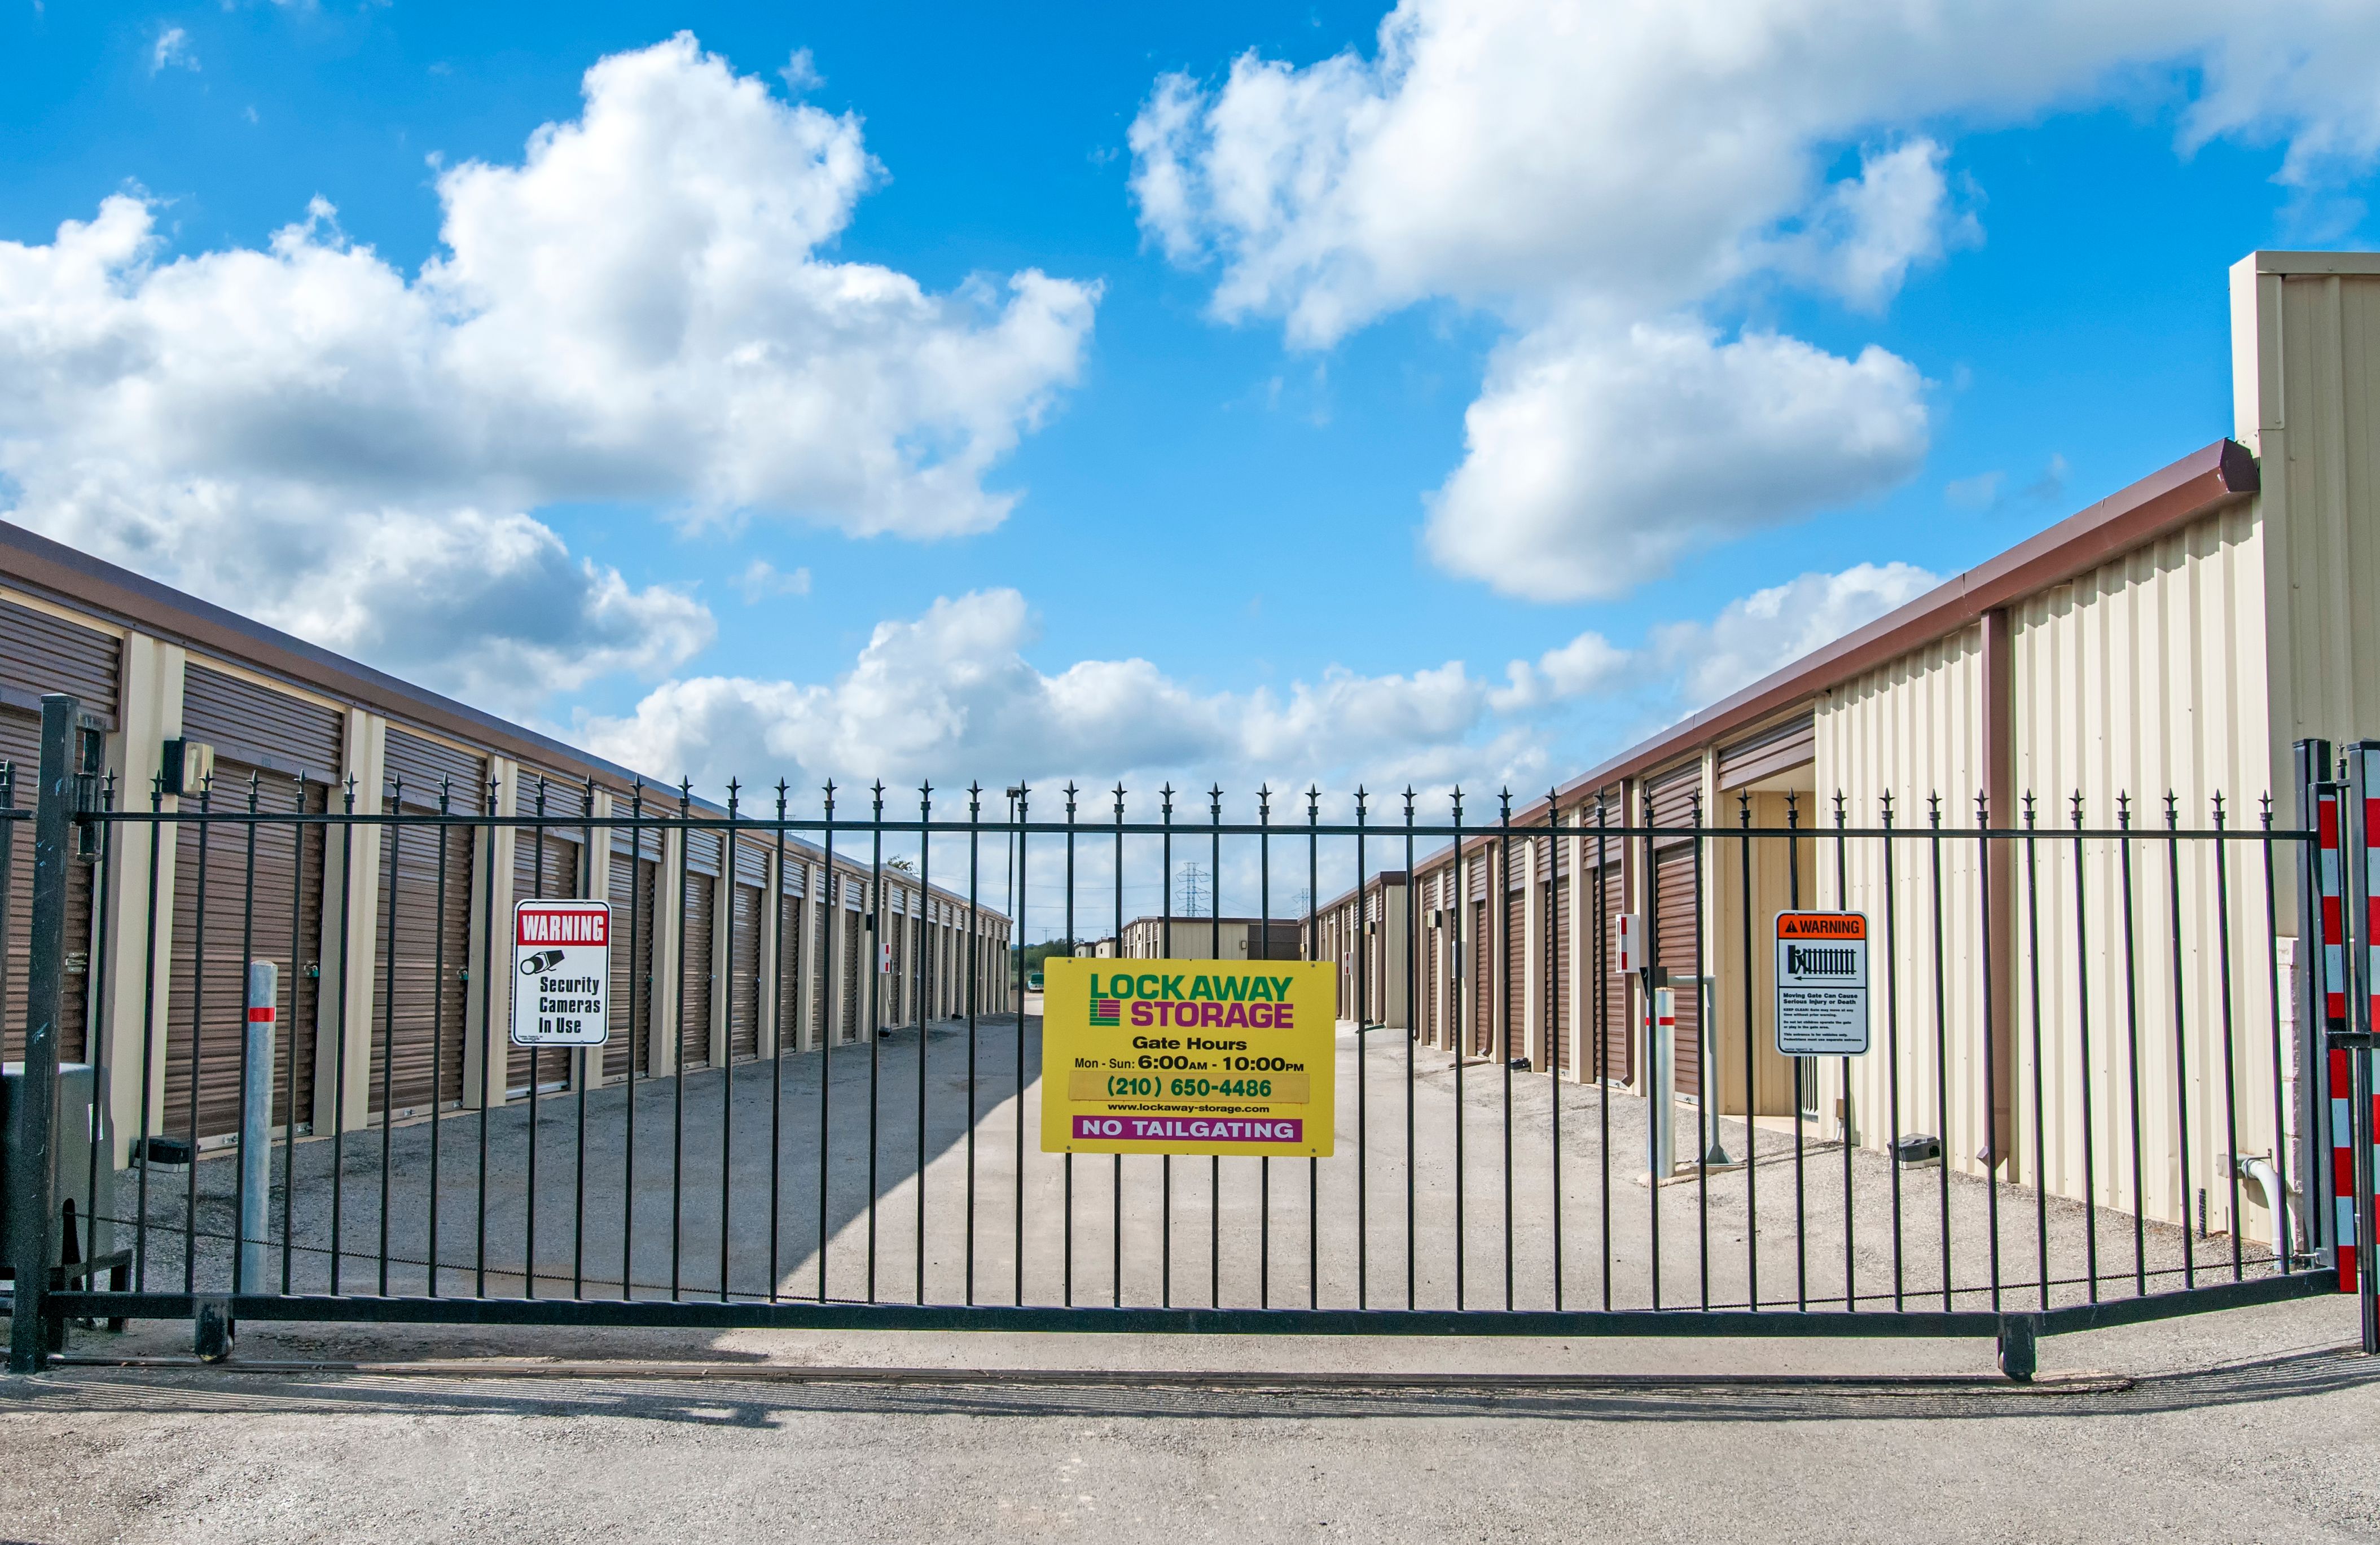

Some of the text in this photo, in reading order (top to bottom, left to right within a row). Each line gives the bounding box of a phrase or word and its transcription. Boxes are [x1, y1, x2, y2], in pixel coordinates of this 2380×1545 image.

[522, 915, 604, 941] WARNING
[1799, 920, 1859, 933] WARNING
[541, 976, 599, 995] Security
[539, 997, 600, 1013] Cameras
[1131, 1001, 1294, 1029] STORAGE
[539, 1017, 581, 1033] In Use
[1132, 1037, 1248, 1051] Gate Hours
[1075, 1058, 1099, 1069] Mon
[1109, 1059, 1135, 1069] Sun:
[1138, 1056, 1207, 1070] 6:00AM
[1223, 1057, 1304, 1072] 10:00PM
[1108, 1076, 1272, 1098] (210) 650-4486
[1108, 1103, 1270, 1114] www.lockaway-storage.com
[1082, 1120, 1294, 1139] NO TAILGATING
